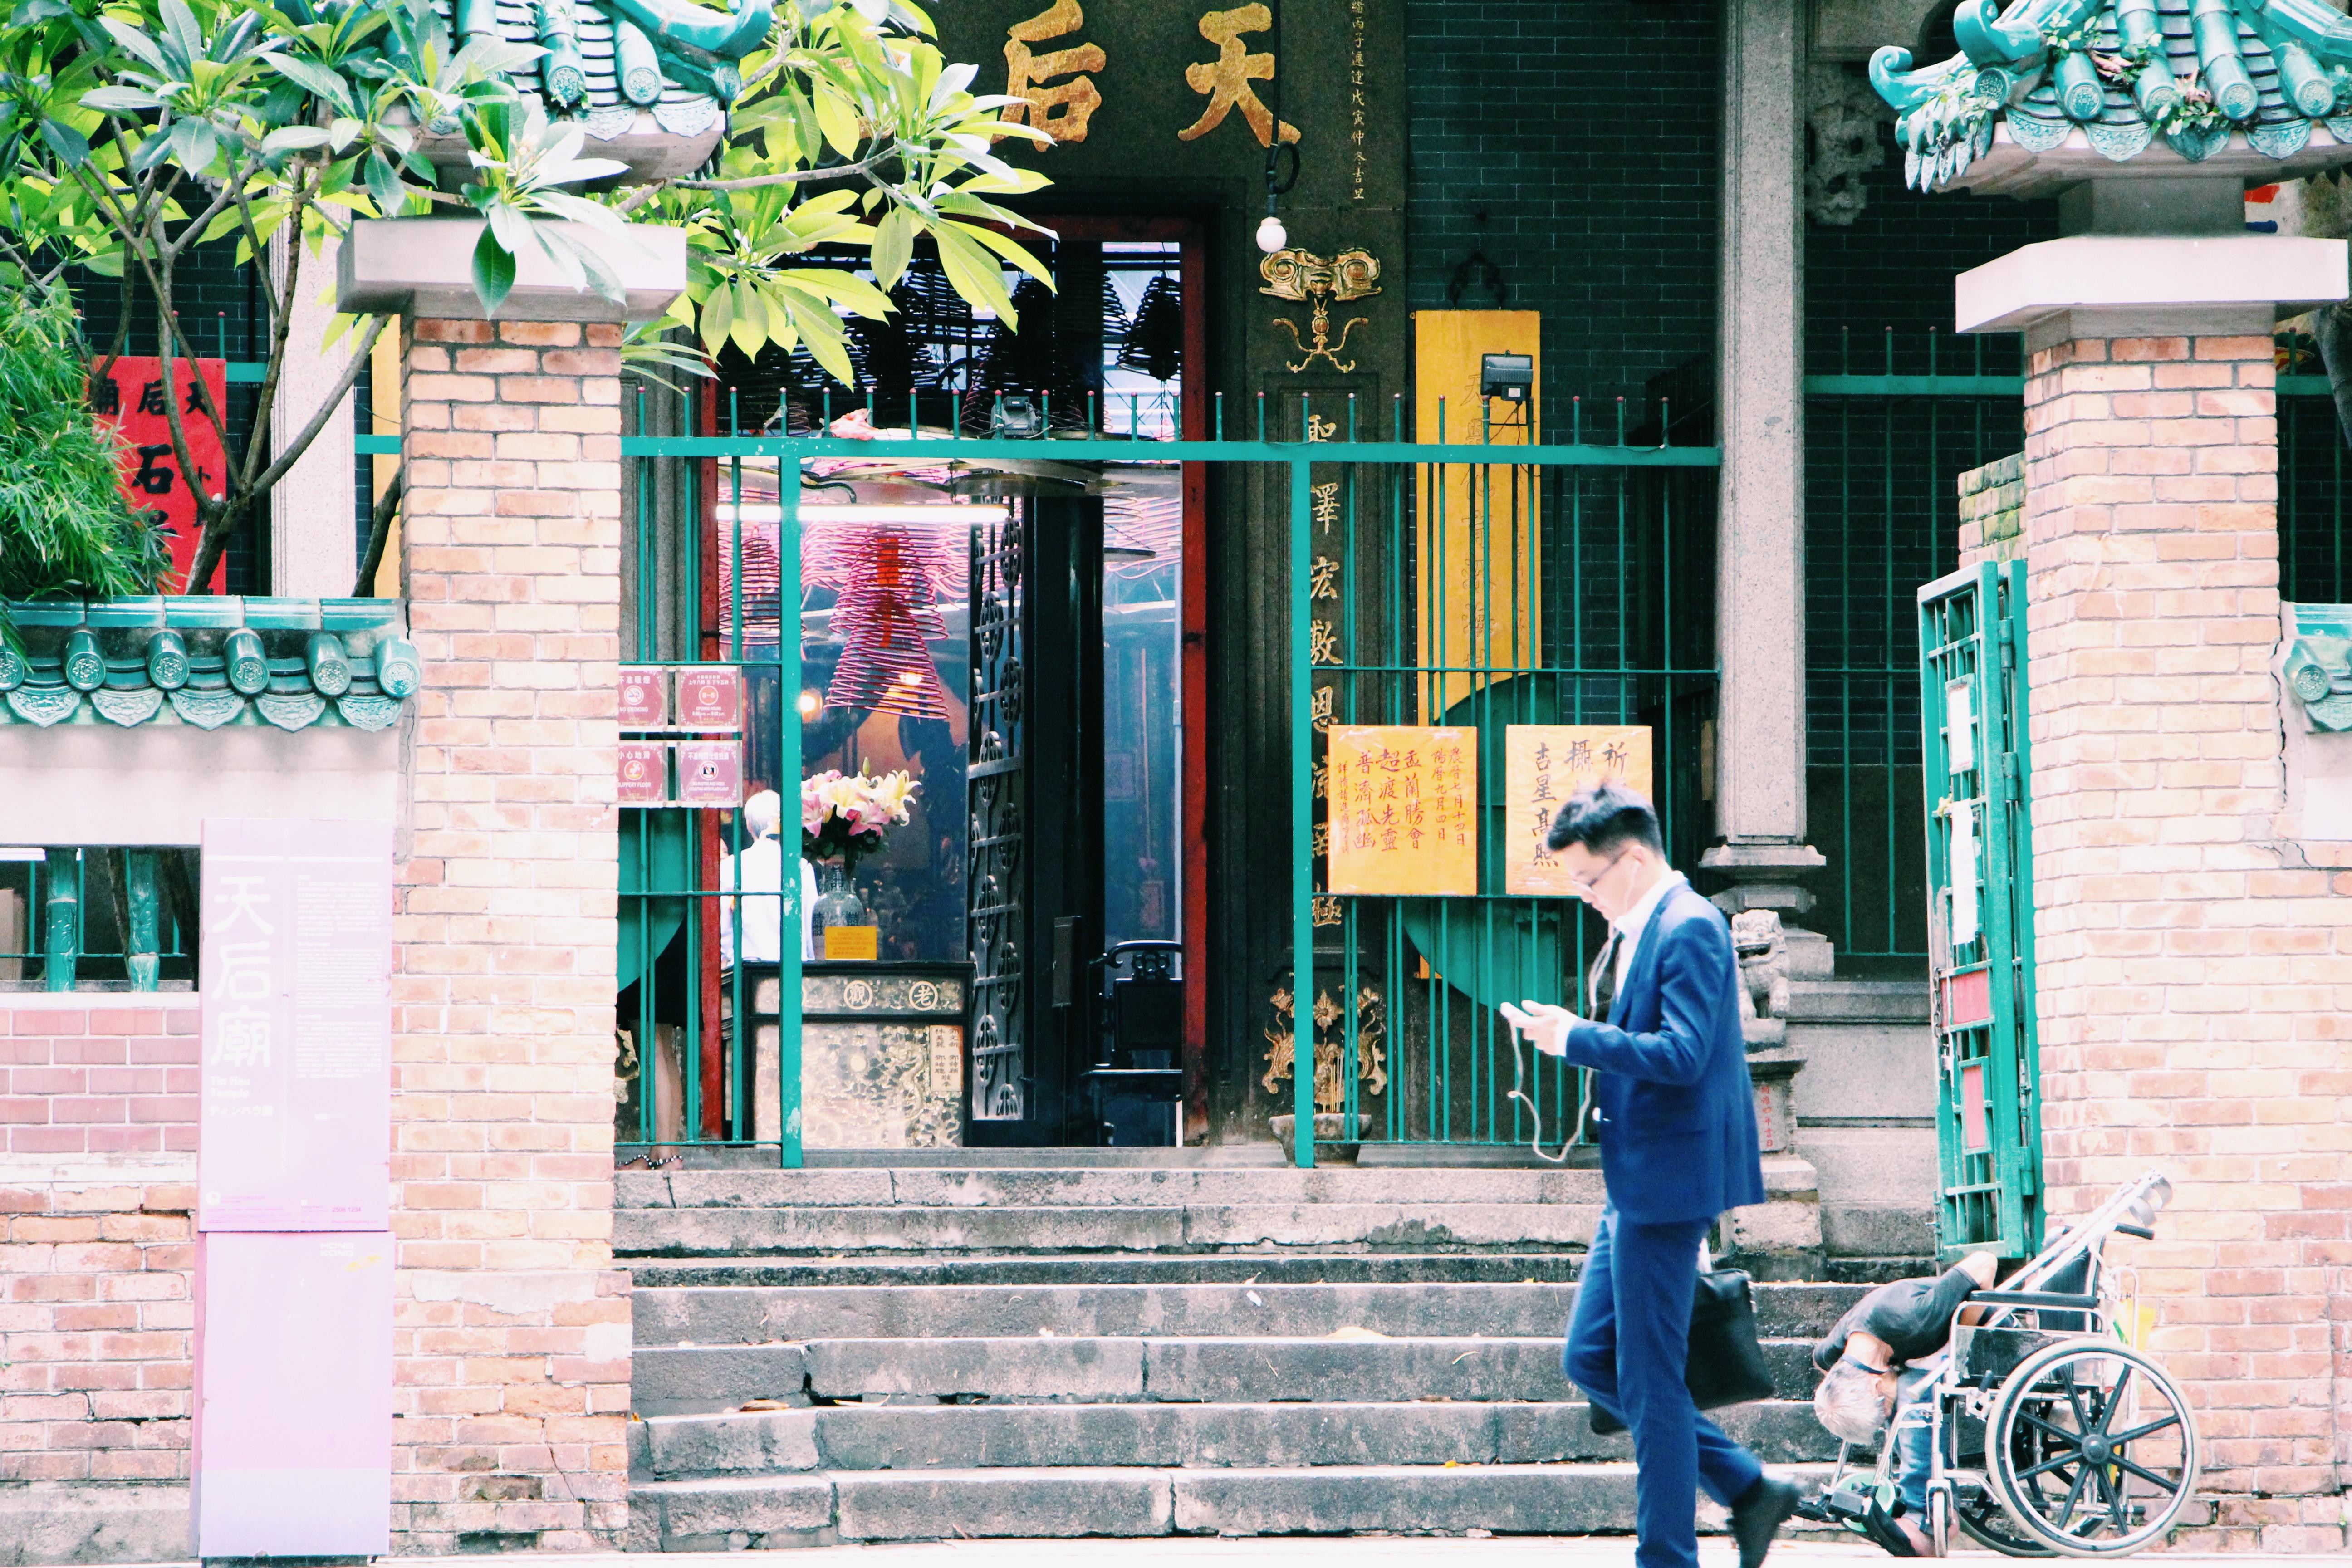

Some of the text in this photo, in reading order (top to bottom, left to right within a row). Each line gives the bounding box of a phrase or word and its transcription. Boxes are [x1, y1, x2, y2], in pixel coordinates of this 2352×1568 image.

[990, 0, 1301, 152] 天后
[1403, 749, 1426, 849] 盂蘭勝會
[211, 875, 276, 1068] 天后廟
[209, 1075, 251, 1086] Tin Hau
[209, 1088, 250, 1099] Temple
